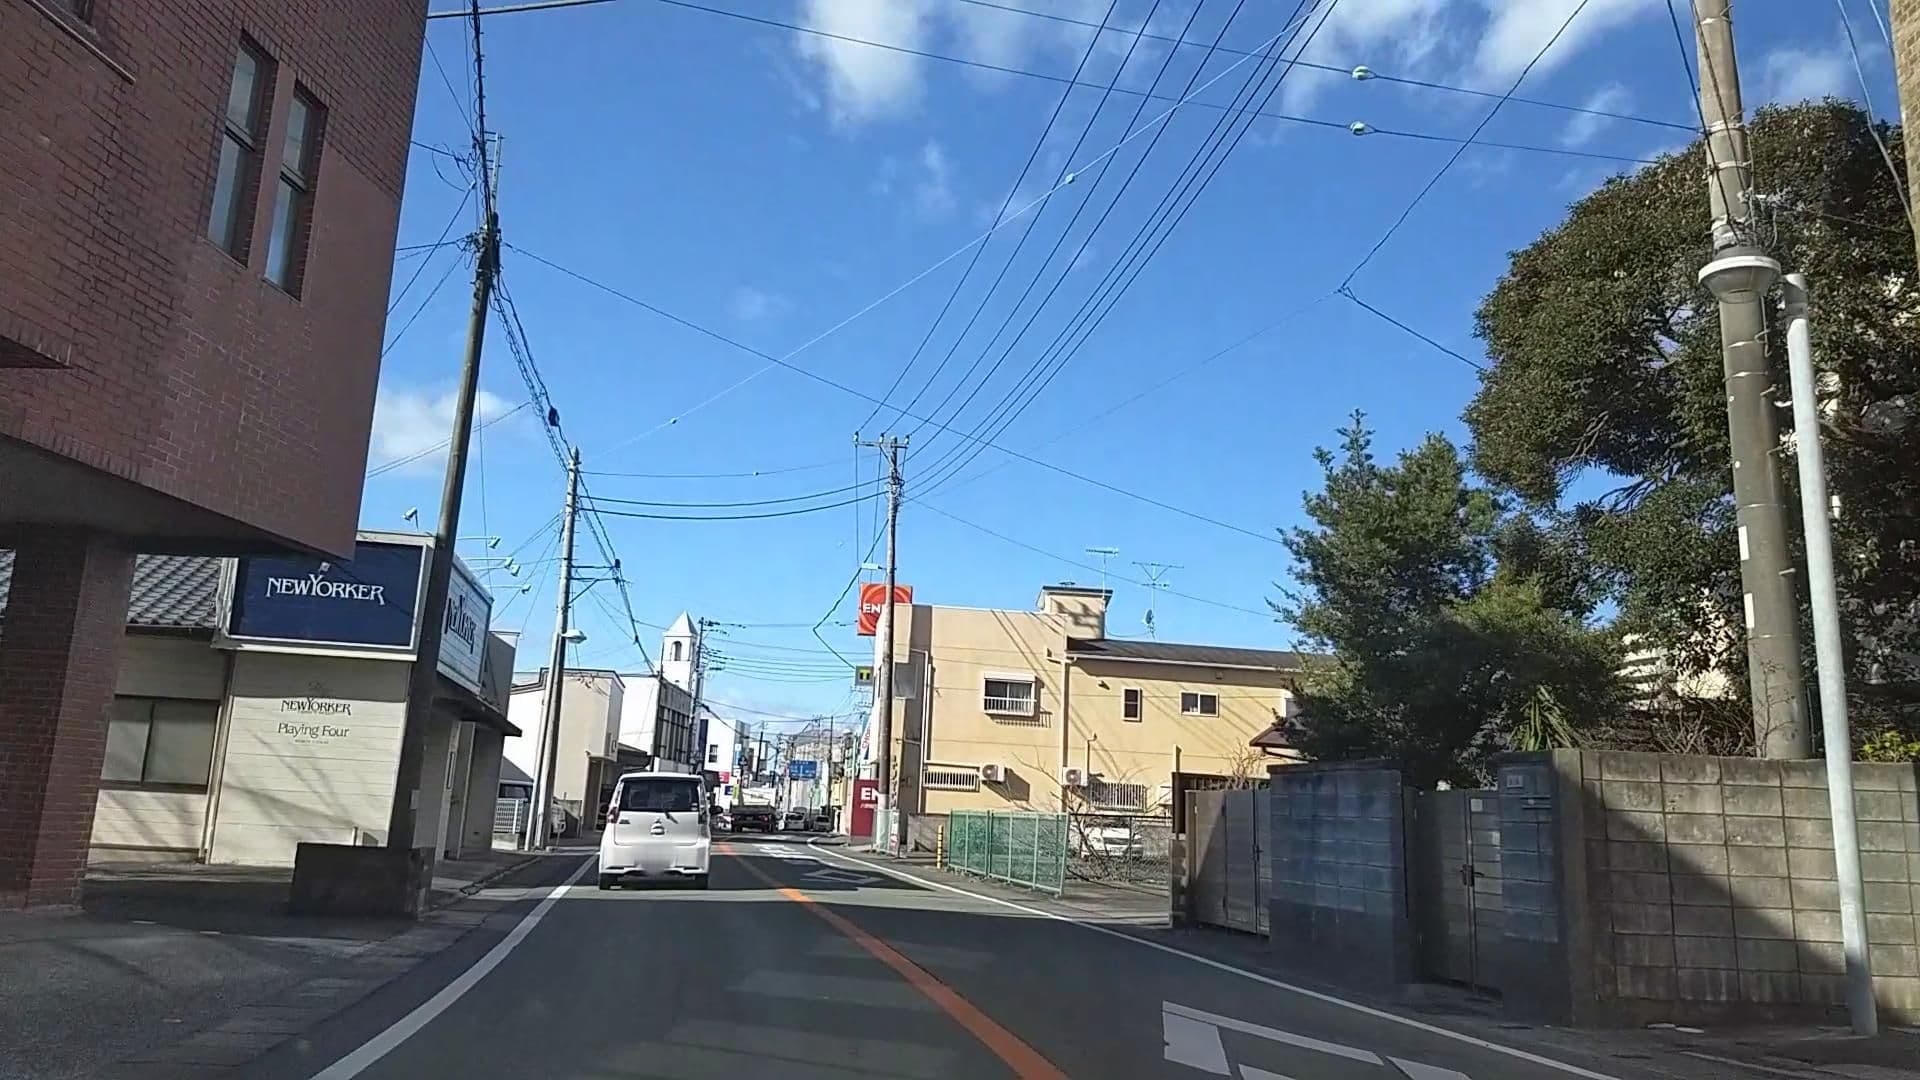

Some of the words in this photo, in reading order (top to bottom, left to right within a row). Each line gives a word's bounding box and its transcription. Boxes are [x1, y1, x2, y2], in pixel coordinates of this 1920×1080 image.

[862, 603, 881, 614] EN
[278, 722, 320, 739] Playing
[322, 725, 350, 737] Four
[860, 787, 878, 800] EN
